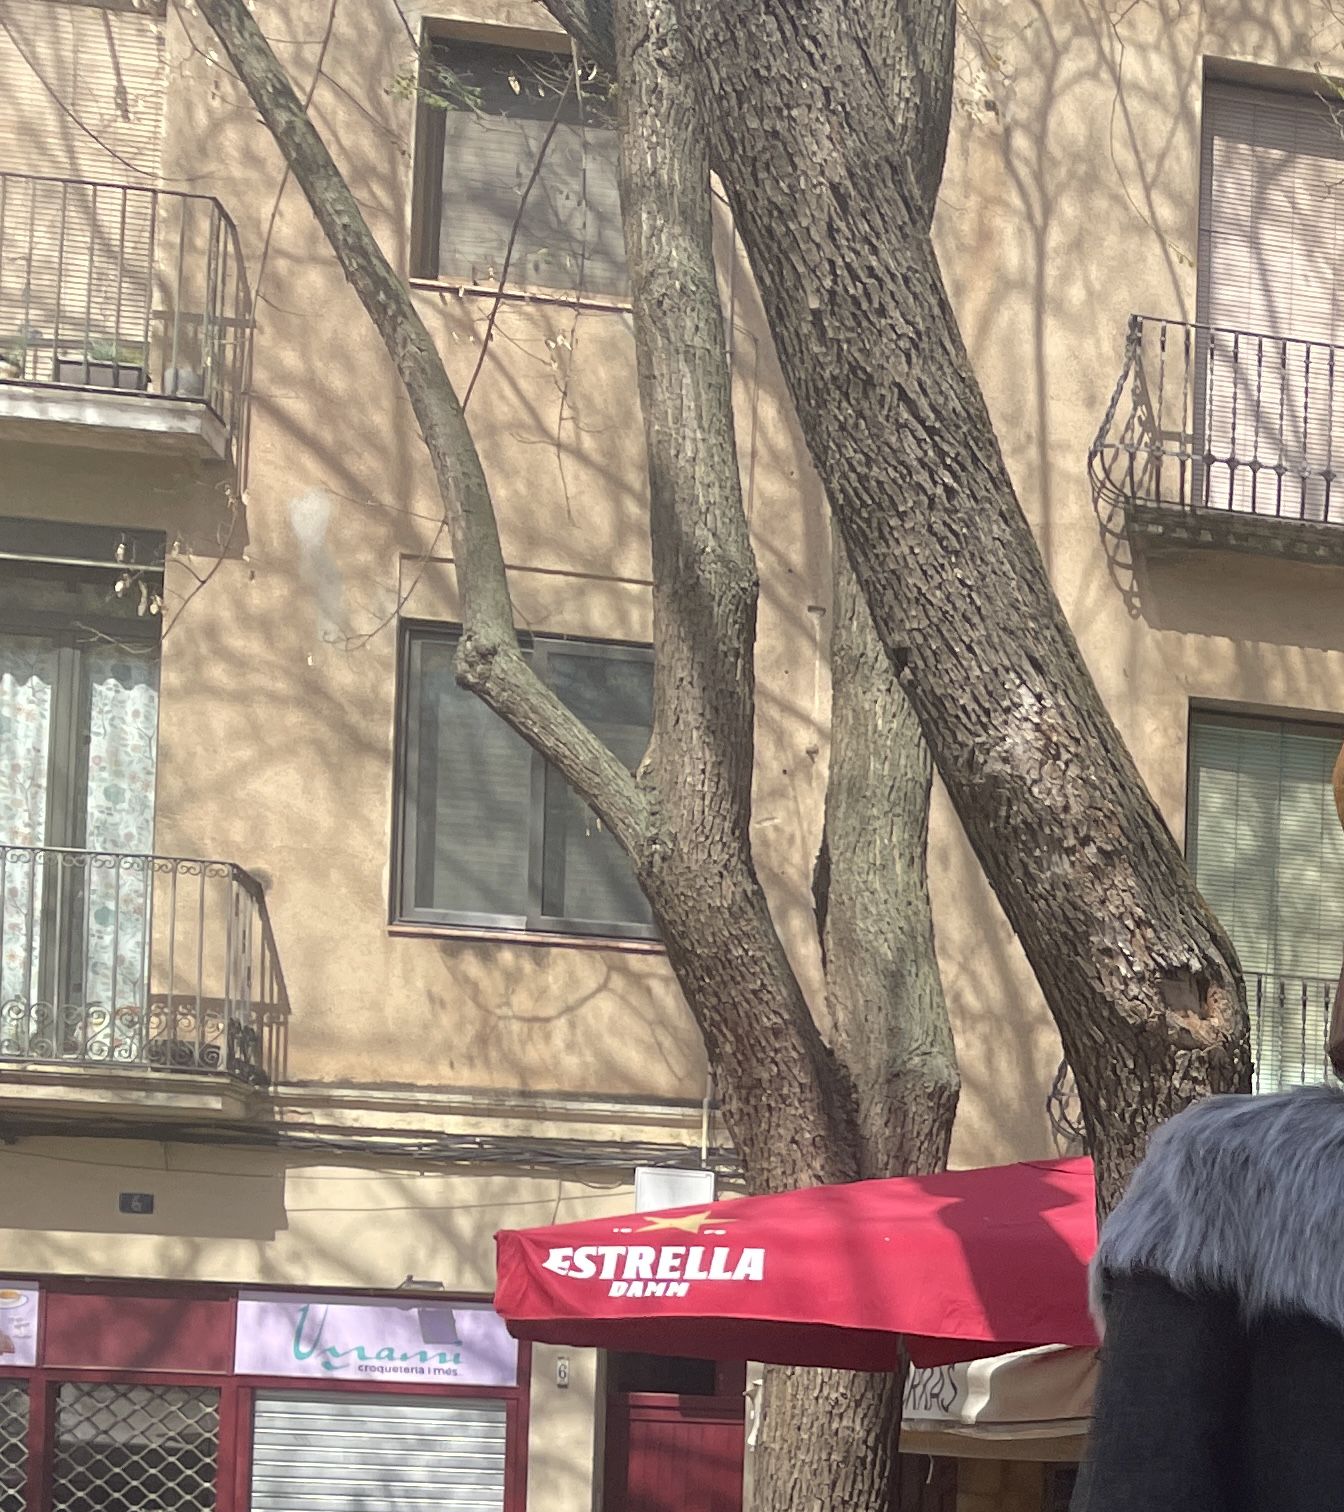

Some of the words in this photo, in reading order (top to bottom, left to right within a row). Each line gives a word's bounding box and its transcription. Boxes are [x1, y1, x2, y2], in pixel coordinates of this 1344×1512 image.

[542, 1246, 766, 1281] ESTRELLA
[608, 1281, 691, 1298] DAMM
[358, 1364, 425, 1374] croqueteria
[558, 1363, 567, 1379] 6
